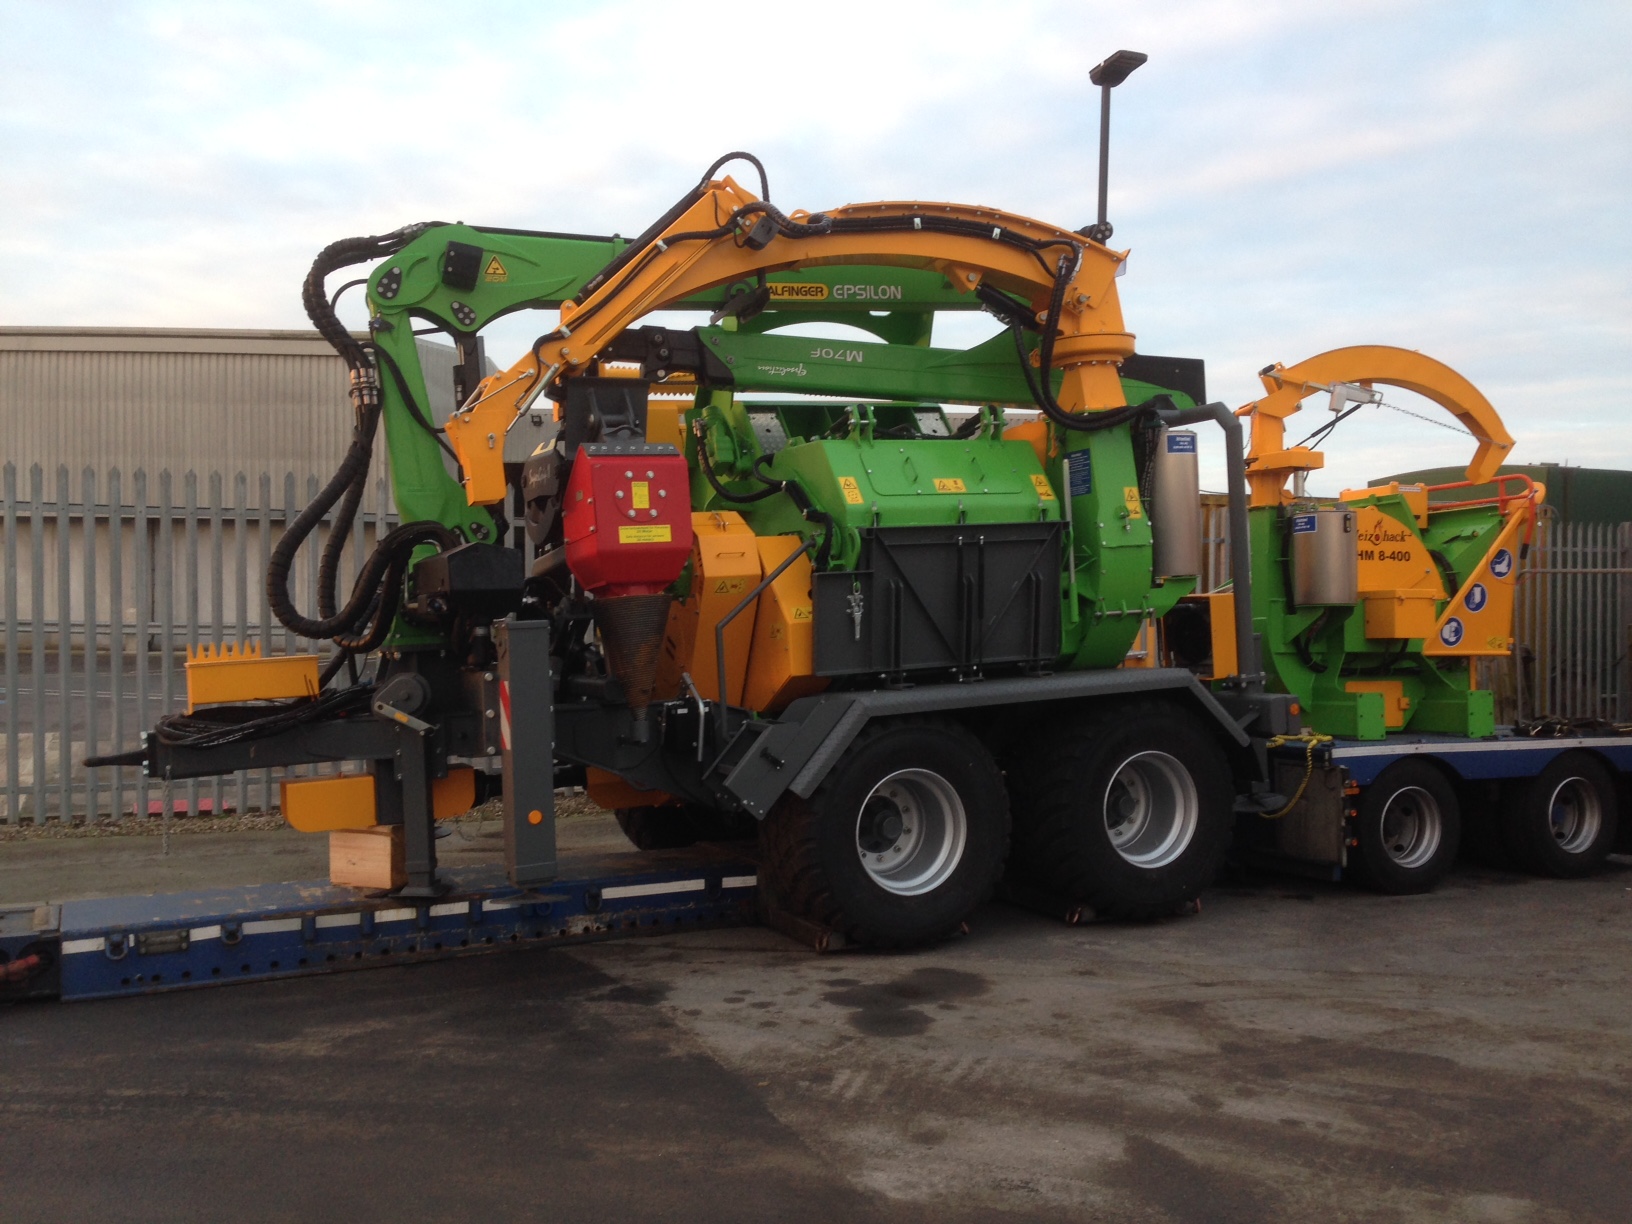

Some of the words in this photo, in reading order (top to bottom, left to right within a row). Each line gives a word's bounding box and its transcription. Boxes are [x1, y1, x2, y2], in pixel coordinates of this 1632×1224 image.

[768, 285, 824, 297] ALFINGER
[833, 284, 902, 299] EPSILON
[810, 347, 863, 363] M70F
[1356, 528, 1412, 546] eizohack
[1357, 550, 1375, 561] HM
[1378, 550, 1411, 562] 8-400
